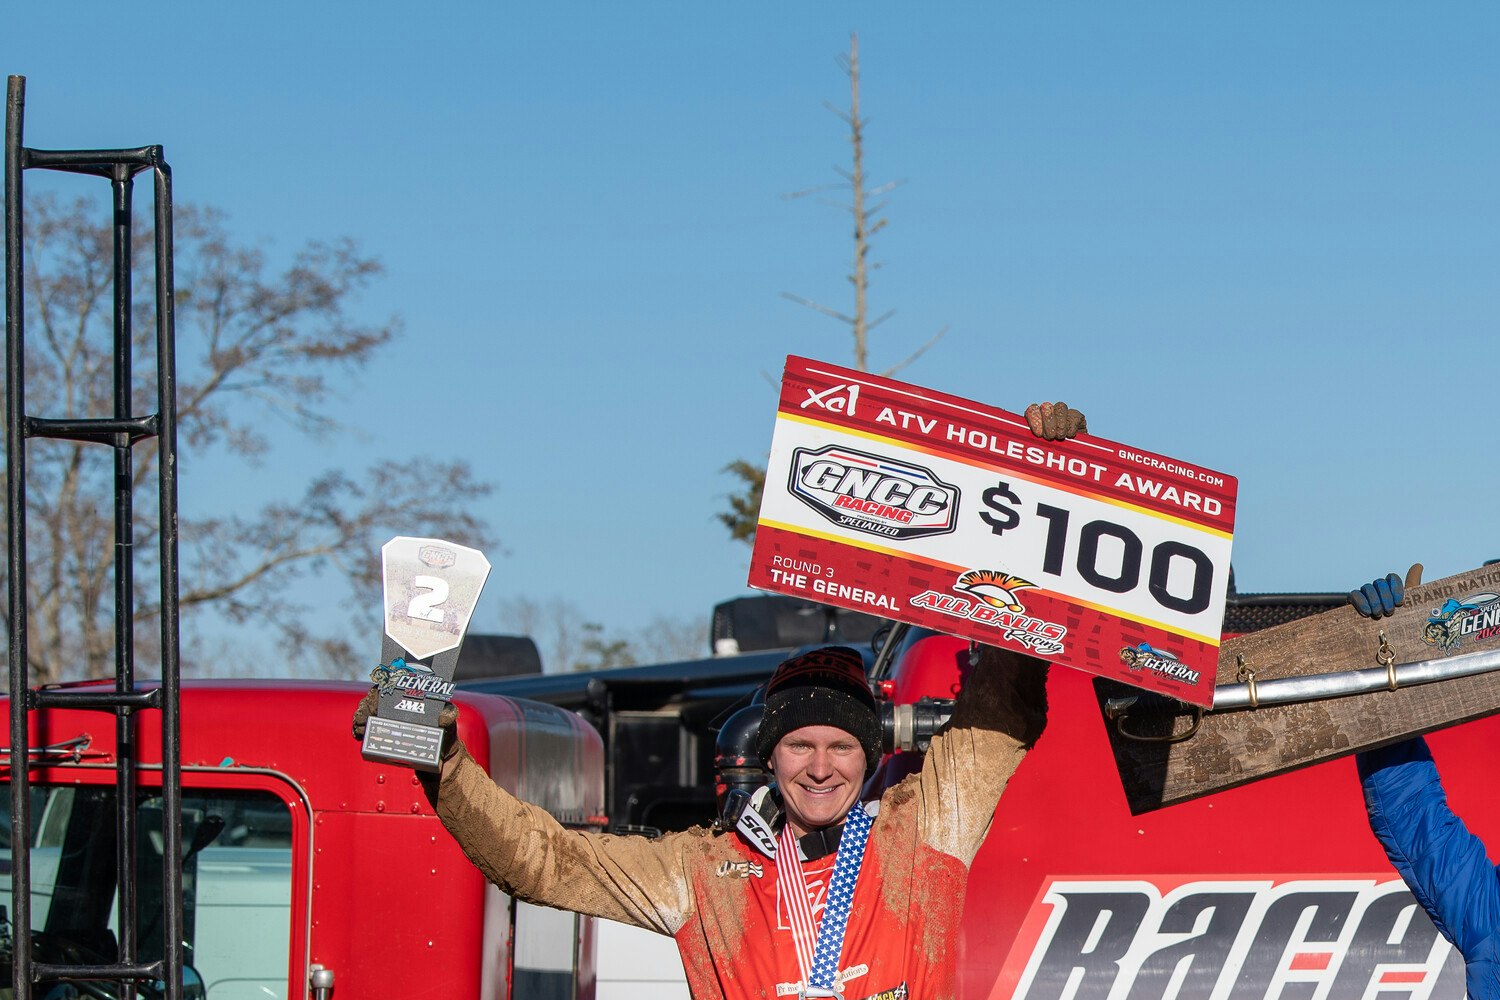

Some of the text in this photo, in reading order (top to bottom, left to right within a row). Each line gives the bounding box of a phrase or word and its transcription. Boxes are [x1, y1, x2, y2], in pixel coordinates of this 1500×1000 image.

[875, 407, 938, 434] ATV
[946, 423, 1107, 482] HOLESHOT
[1114, 473, 1222, 516] AWARD
[1118, 449, 1224, 488] GNCCRACING.COM
[801, 459, 949, 516] GNCC
[833, 494, 914, 525] RACING
[837, 515, 900, 537] SPECIALIZED
[978, 480, 1214, 615] $100
[772, 554, 835, 579] ROUND 3
[407, 575, 450, 624] 2
[770, 569, 900, 612] THE GENERAL
[1403, 584, 1456, 608] GRAND
[911, 591, 1067, 641] ALL BALLS
[1004, 628, 1064, 654] Racing
[1144, 657, 1200, 682] GENERAL
[396, 675, 455, 695] GENERAL
[394, 699, 425, 714] AMA
[777, 985, 799, 995] Prme
